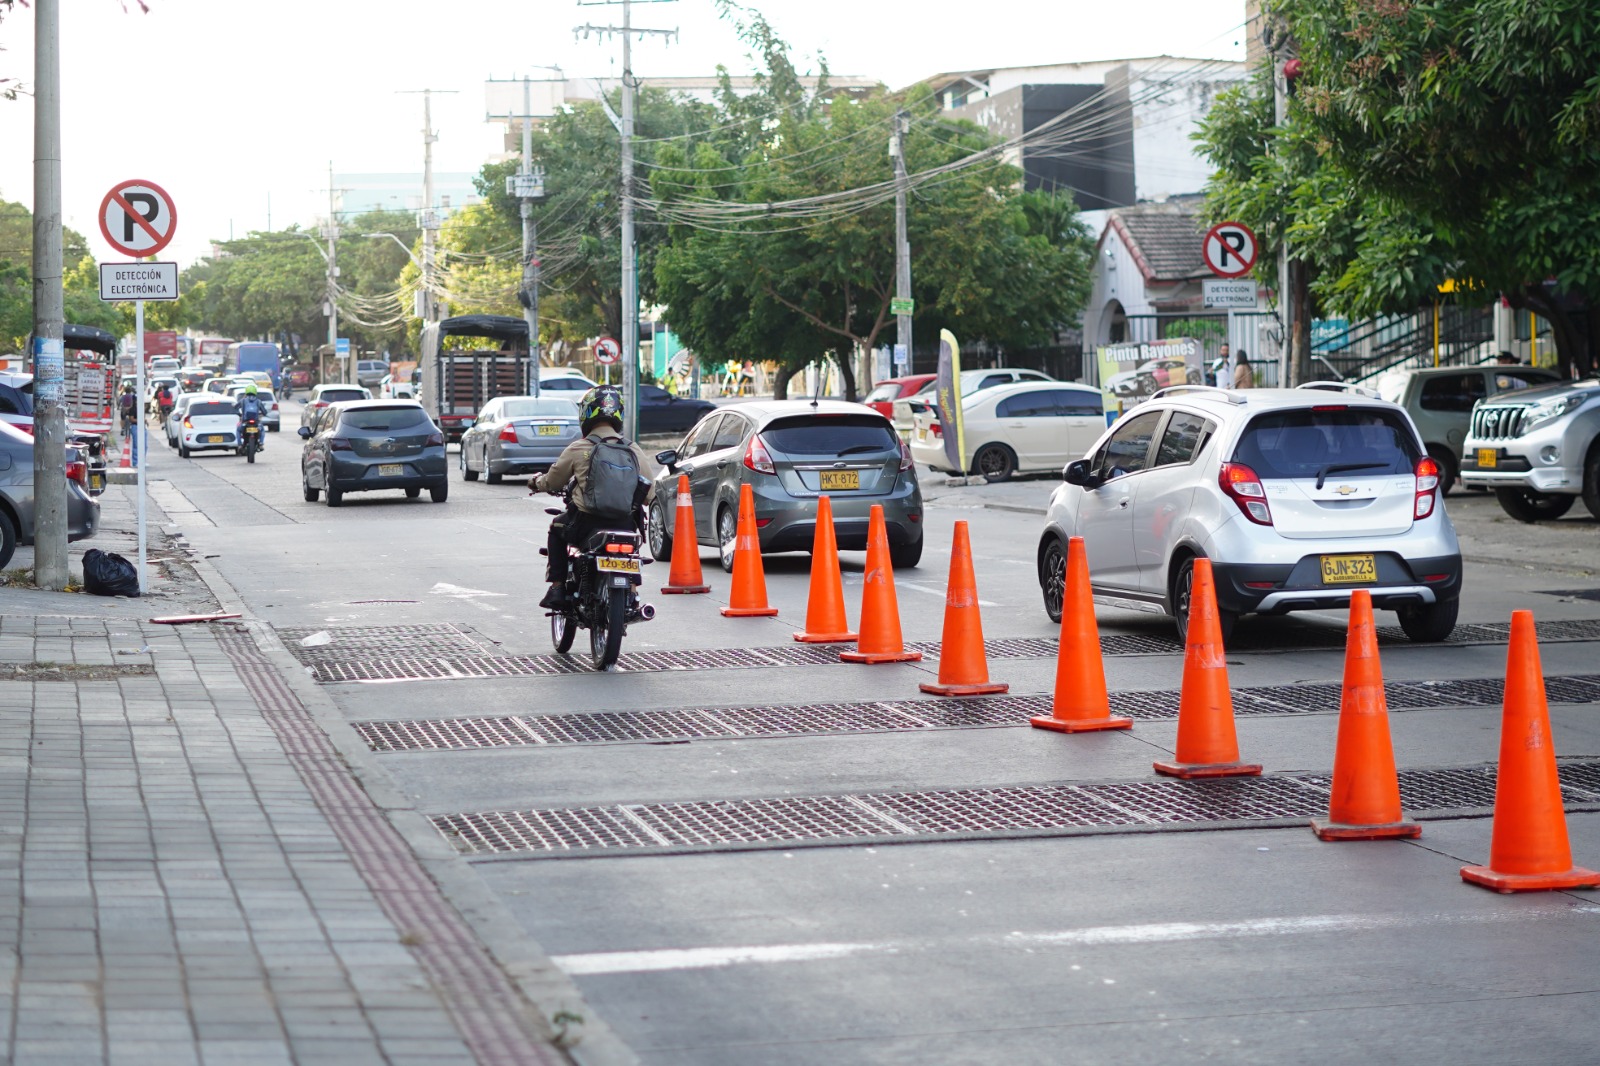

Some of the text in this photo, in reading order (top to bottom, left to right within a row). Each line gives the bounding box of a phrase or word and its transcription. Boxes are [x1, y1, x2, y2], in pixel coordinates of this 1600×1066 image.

[124, 193, 159, 242] P
[1220, 231, 1245, 267] P
[115, 268, 162, 281] DETECCIÓN
[111, 282, 167, 294] ELECTRÓNICA
[1210, 285, 1250, 293] DETECCIÓN
[1206, 294, 1254, 303] ELECTRÓNICA
[1105, 342, 1195, 362] Pintu Rayones
[821, 473, 858, 484] HKT-872
[1323, 559, 1374, 576] GJN-323
